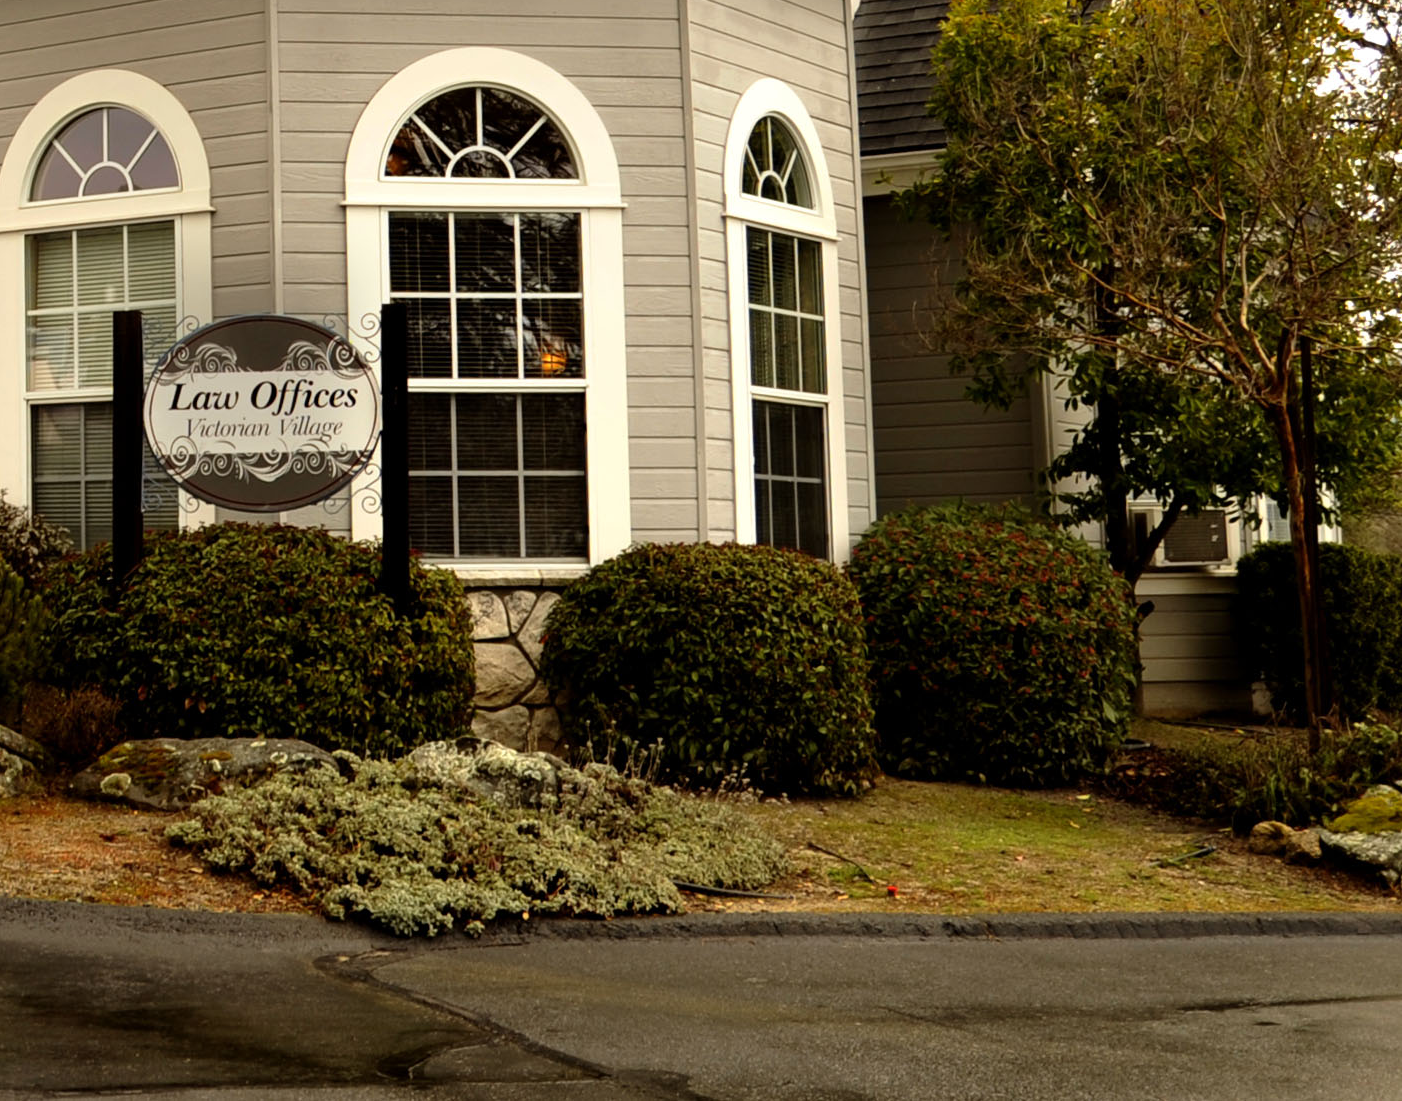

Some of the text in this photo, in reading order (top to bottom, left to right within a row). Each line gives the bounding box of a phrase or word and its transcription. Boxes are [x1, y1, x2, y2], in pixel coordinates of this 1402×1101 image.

[168, 378, 358, 417] Law Offices
[186, 416, 343, 441] Victorian Village
